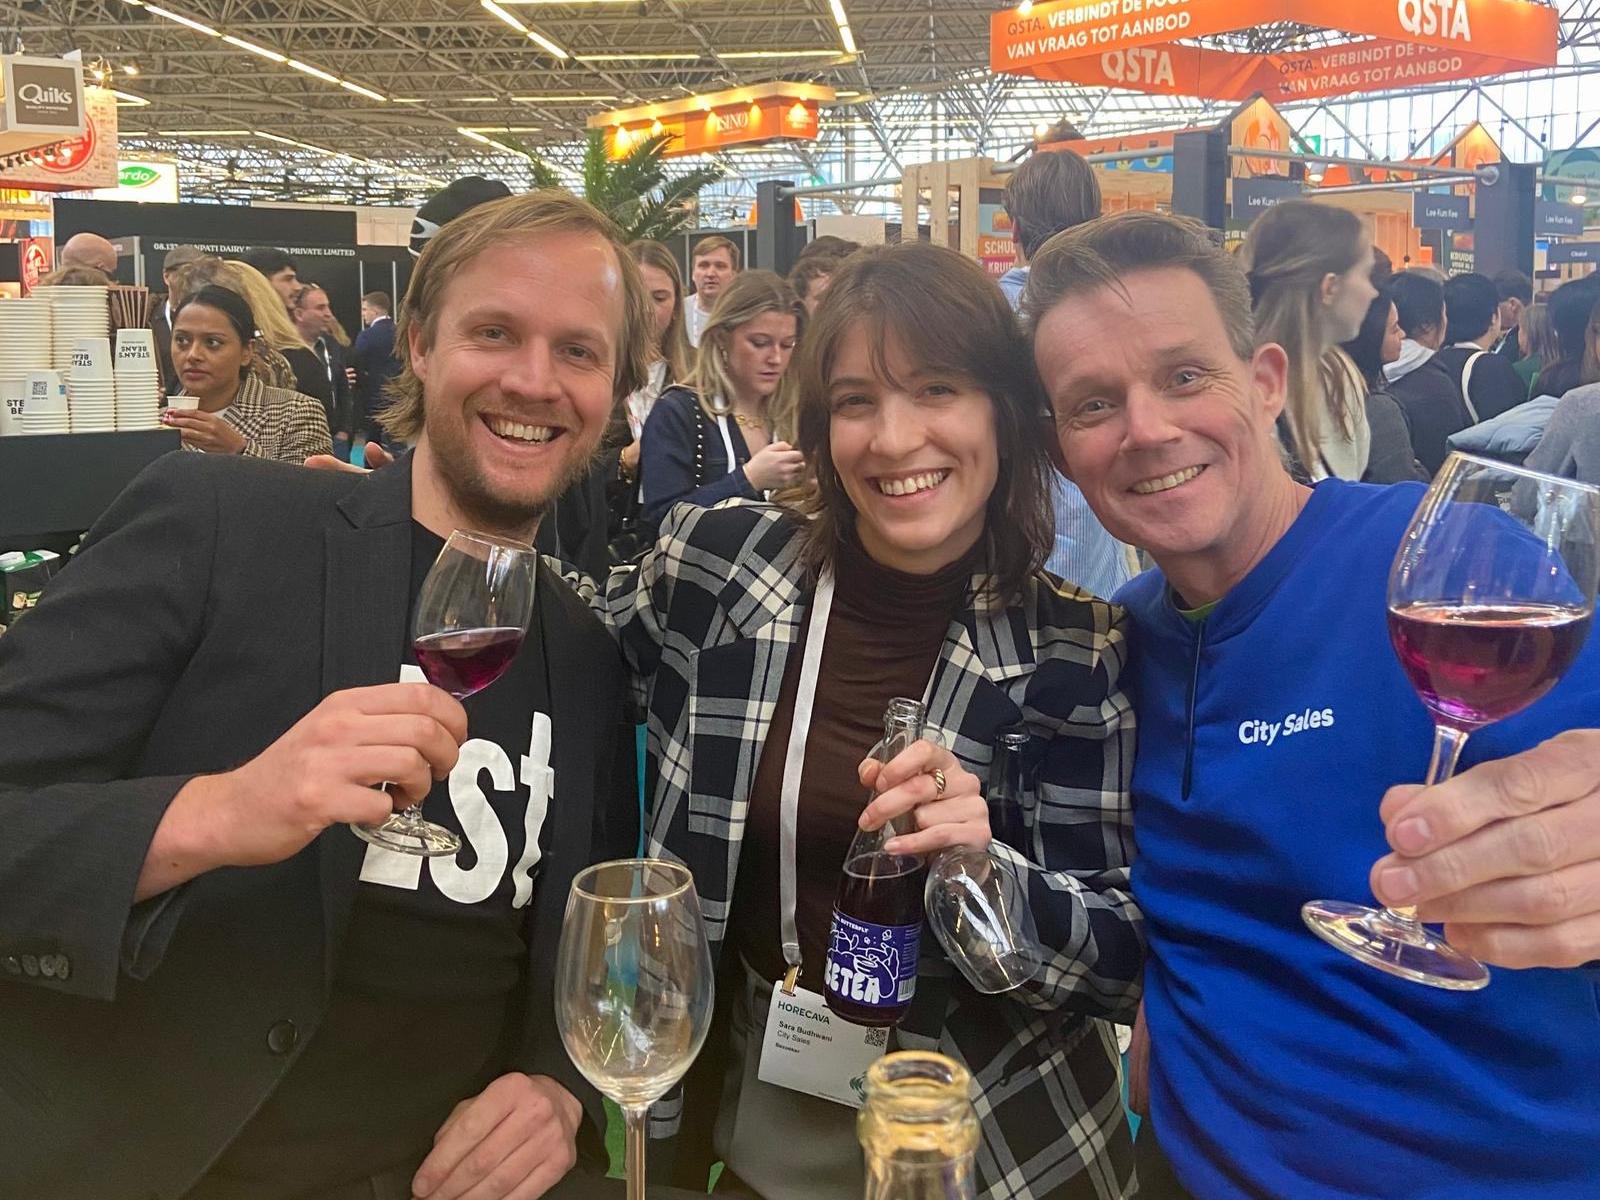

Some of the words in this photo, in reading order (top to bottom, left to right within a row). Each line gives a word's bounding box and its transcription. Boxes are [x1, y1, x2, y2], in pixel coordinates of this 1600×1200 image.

[1047, 1, 1119, 29] VERBINDT
[1122, 0, 1142, 15] DE
[1397, 0, 1472, 42] QSTA
[1007, 40, 1035, 60] VAN
[1038, 30, 1088, 54] VRAAG
[1090, 24, 1119, 45] TOT
[1121, 11, 1190, 39] AANBOD
[1101, 47, 1175, 88] QSTA
[1321, 45, 1392, 69] VERBINDT
[1395, 42, 1414, 58] DE
[1278, 78, 1308, 94] VAN
[1310, 71, 1360, 91] VRAAG
[1363, 66, 1392, 83] TOT
[1394, 56, 1462, 80] AANBOD
[220, 244, 245, 253] DAIRY
[290, 247, 322, 255] PRIVATE
[323, 248, 356, 257] LIMITED
[1238, 719, 1281, 746] City
[1282, 708, 1334, 736] Sales
[777, 1001, 830, 1025] HORECAVA
[779, 1020, 796, 1032] Sara
[776, 1030, 791, 1041] City
